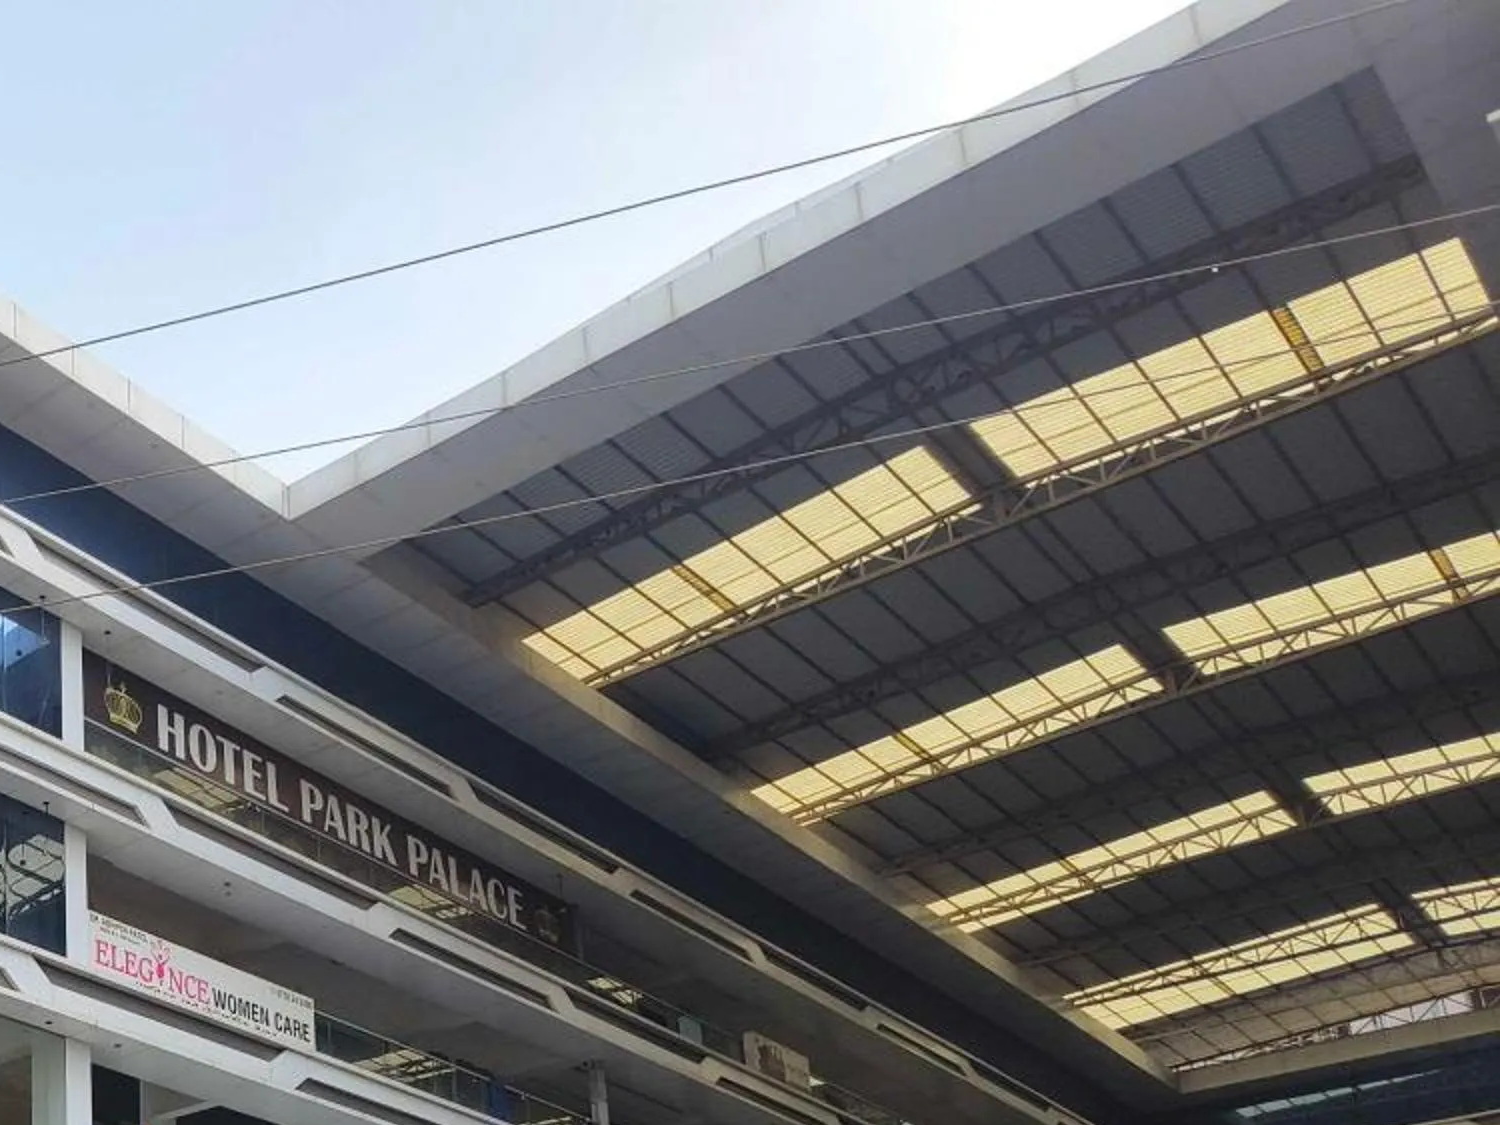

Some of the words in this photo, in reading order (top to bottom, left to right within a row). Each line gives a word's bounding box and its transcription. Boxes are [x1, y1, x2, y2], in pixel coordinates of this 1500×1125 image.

[157, 703, 289, 811] HOTEL
[300, 777, 398, 866] PARK
[407, 834, 529, 932] PALACE
[212, 987, 269, 1026] WOMEN
[274, 1012, 311, 1043] CARE
